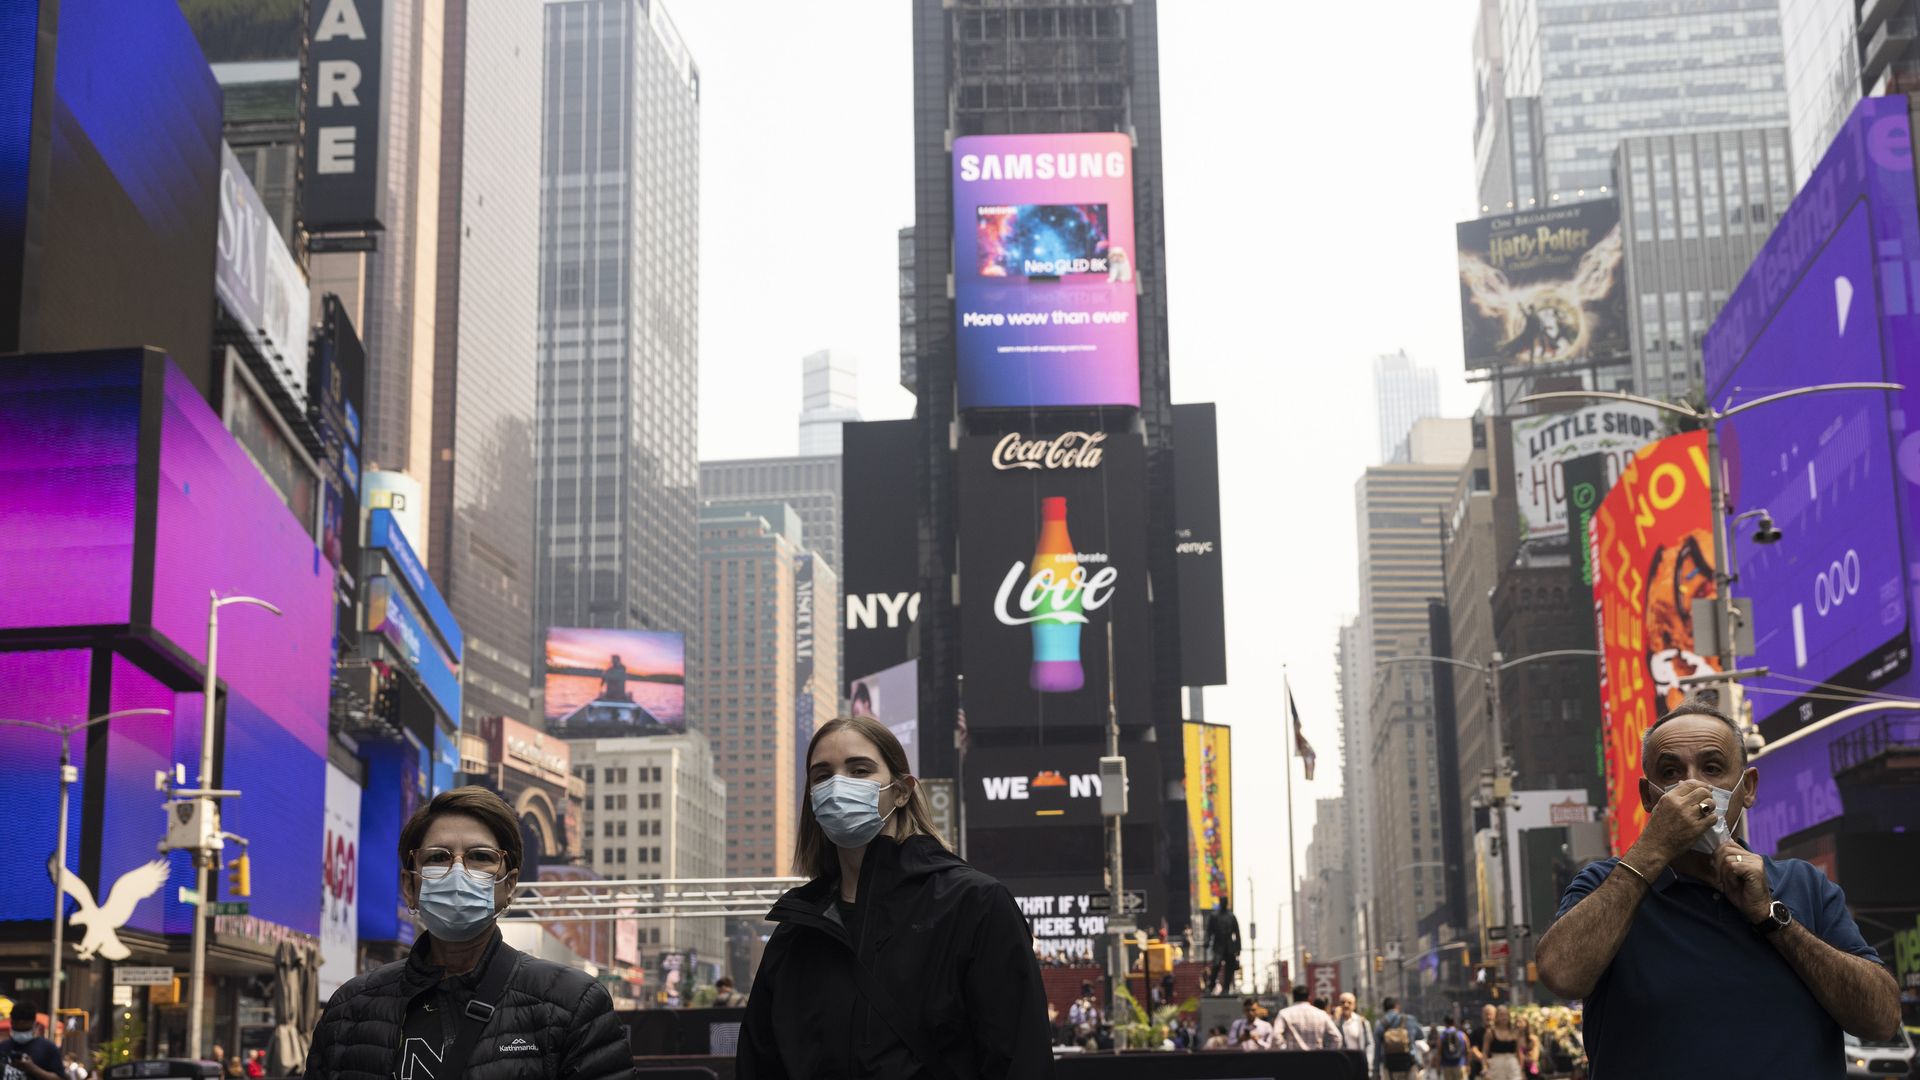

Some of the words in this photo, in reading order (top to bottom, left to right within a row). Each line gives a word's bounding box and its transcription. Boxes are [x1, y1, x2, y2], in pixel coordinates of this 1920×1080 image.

[960, 151, 1125, 182] SAMSUNG
[1489, 233, 1537, 265] Harry
[1536, 225, 1590, 257] Potter
[1024, 259, 1053, 273] Neo
[963, 312, 1005, 327] More
[1007, 312, 1049, 326] wow
[1051, 310, 1090, 324] than
[1092, 311, 1129, 324] ever
[1529, 412, 1598, 459] LITTLE
[1602, 411, 1654, 439] SHOP
[992, 431, 1108, 470] Coca-Cola
[1055, 552, 1108, 563] celebrate
[994, 560, 1118, 626] Love
[982, 776, 1029, 800] WE
[1069, 774, 1106, 798] NY
[1058, 895, 1075, 914] IF
[1033, 917, 1075, 936] HERE
